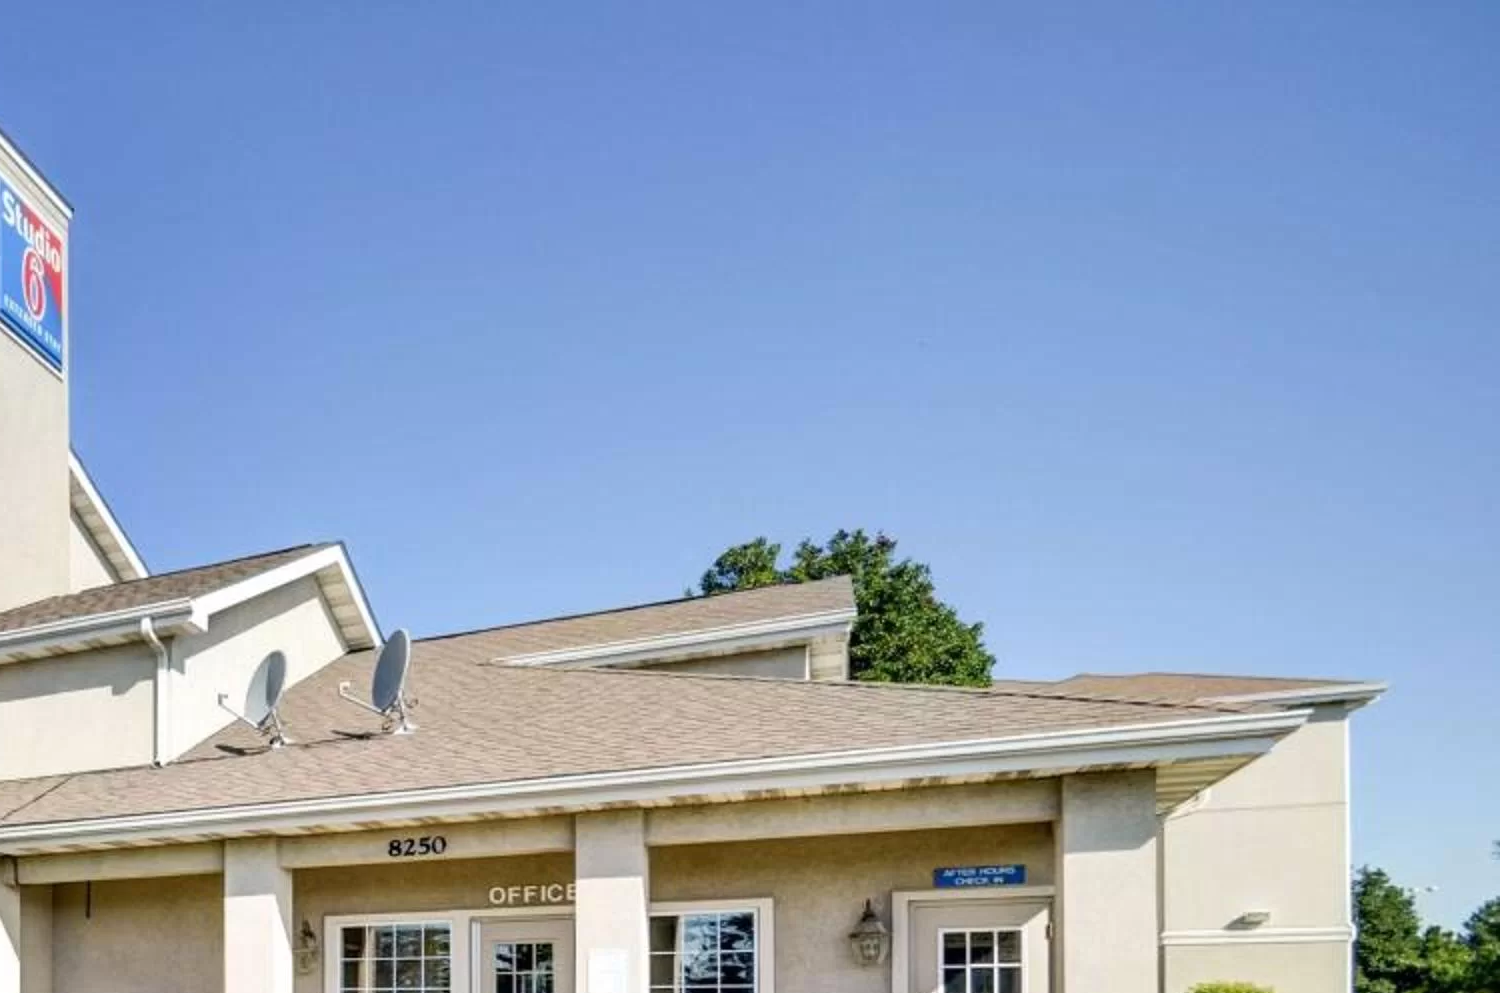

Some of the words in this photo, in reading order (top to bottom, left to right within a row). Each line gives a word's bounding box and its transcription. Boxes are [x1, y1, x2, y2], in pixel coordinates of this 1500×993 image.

[1, 190, 61, 273] Studio
[21, 247, 46, 321] 6
[388, 836, 447, 857] 8250
[943, 868, 977, 877] AFTER
[489, 883, 576, 904] OFFICE
